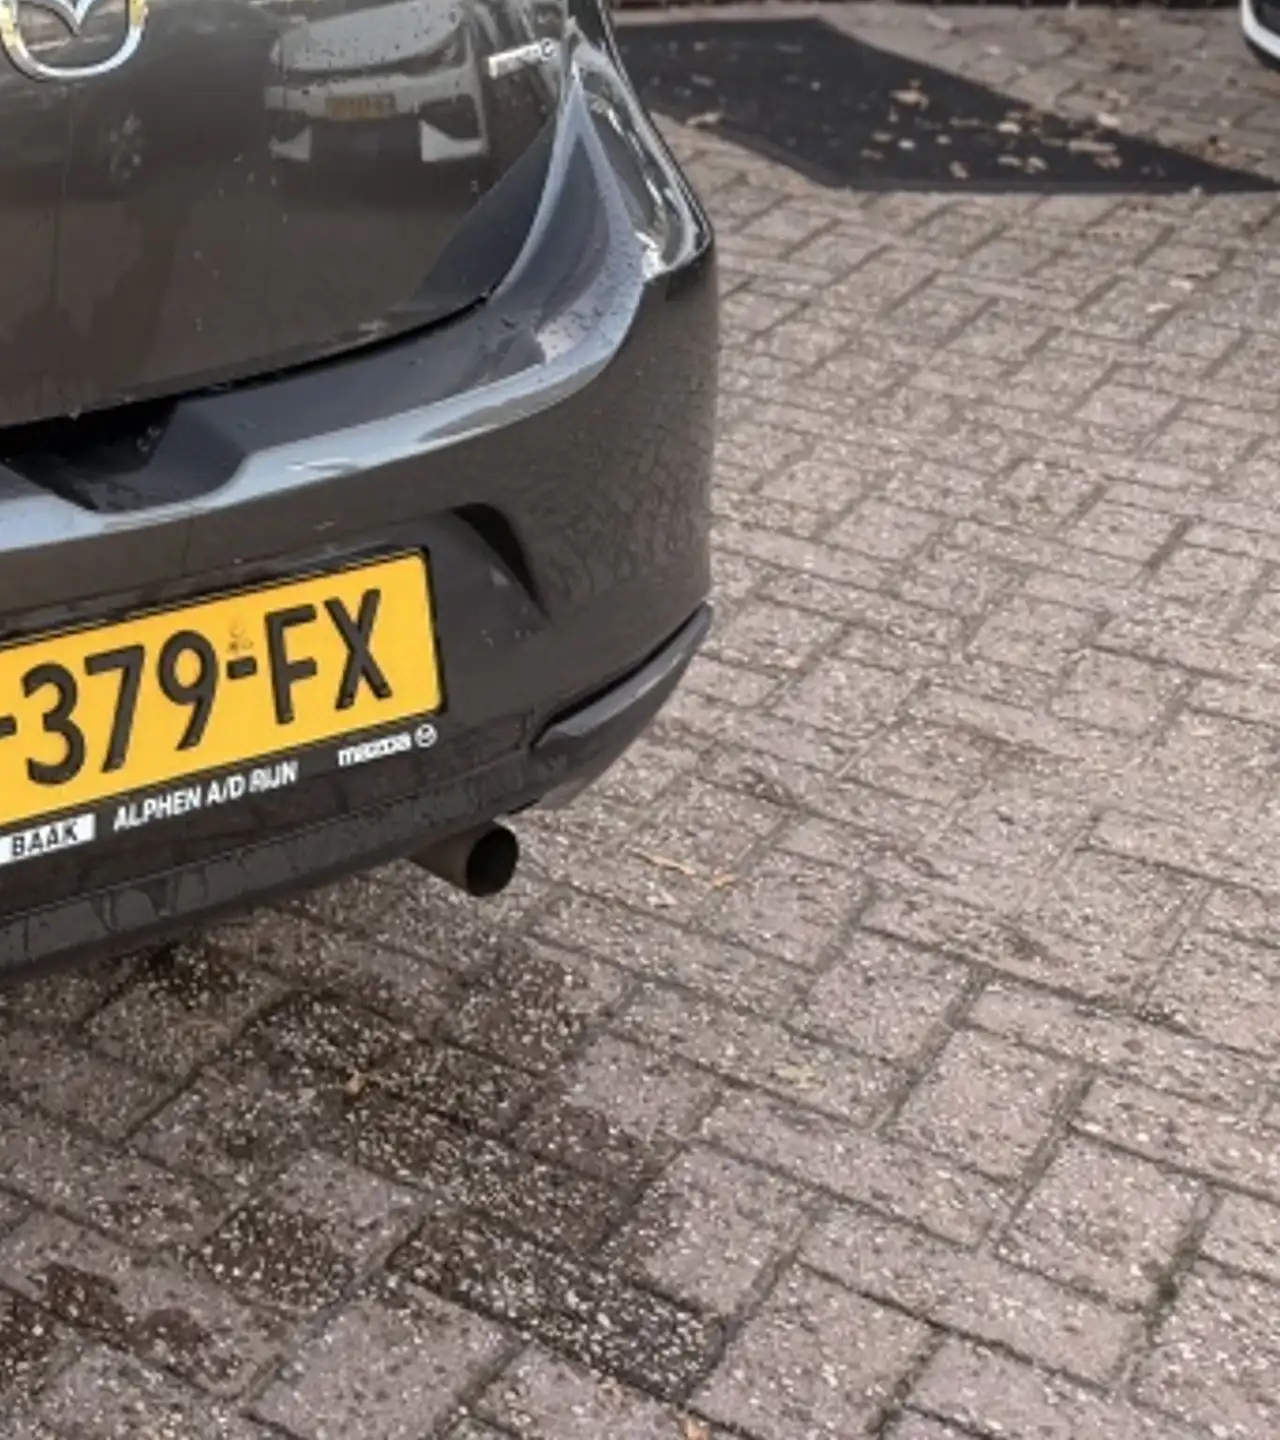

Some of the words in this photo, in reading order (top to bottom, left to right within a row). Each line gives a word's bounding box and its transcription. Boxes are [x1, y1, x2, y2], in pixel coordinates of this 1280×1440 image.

[11, 819, 80, 858] BAAK
[113, 788, 202, 832] ALPHEN
[205, 772, 246, 807] A/D
[248, 761, 299, 794] RIJN
